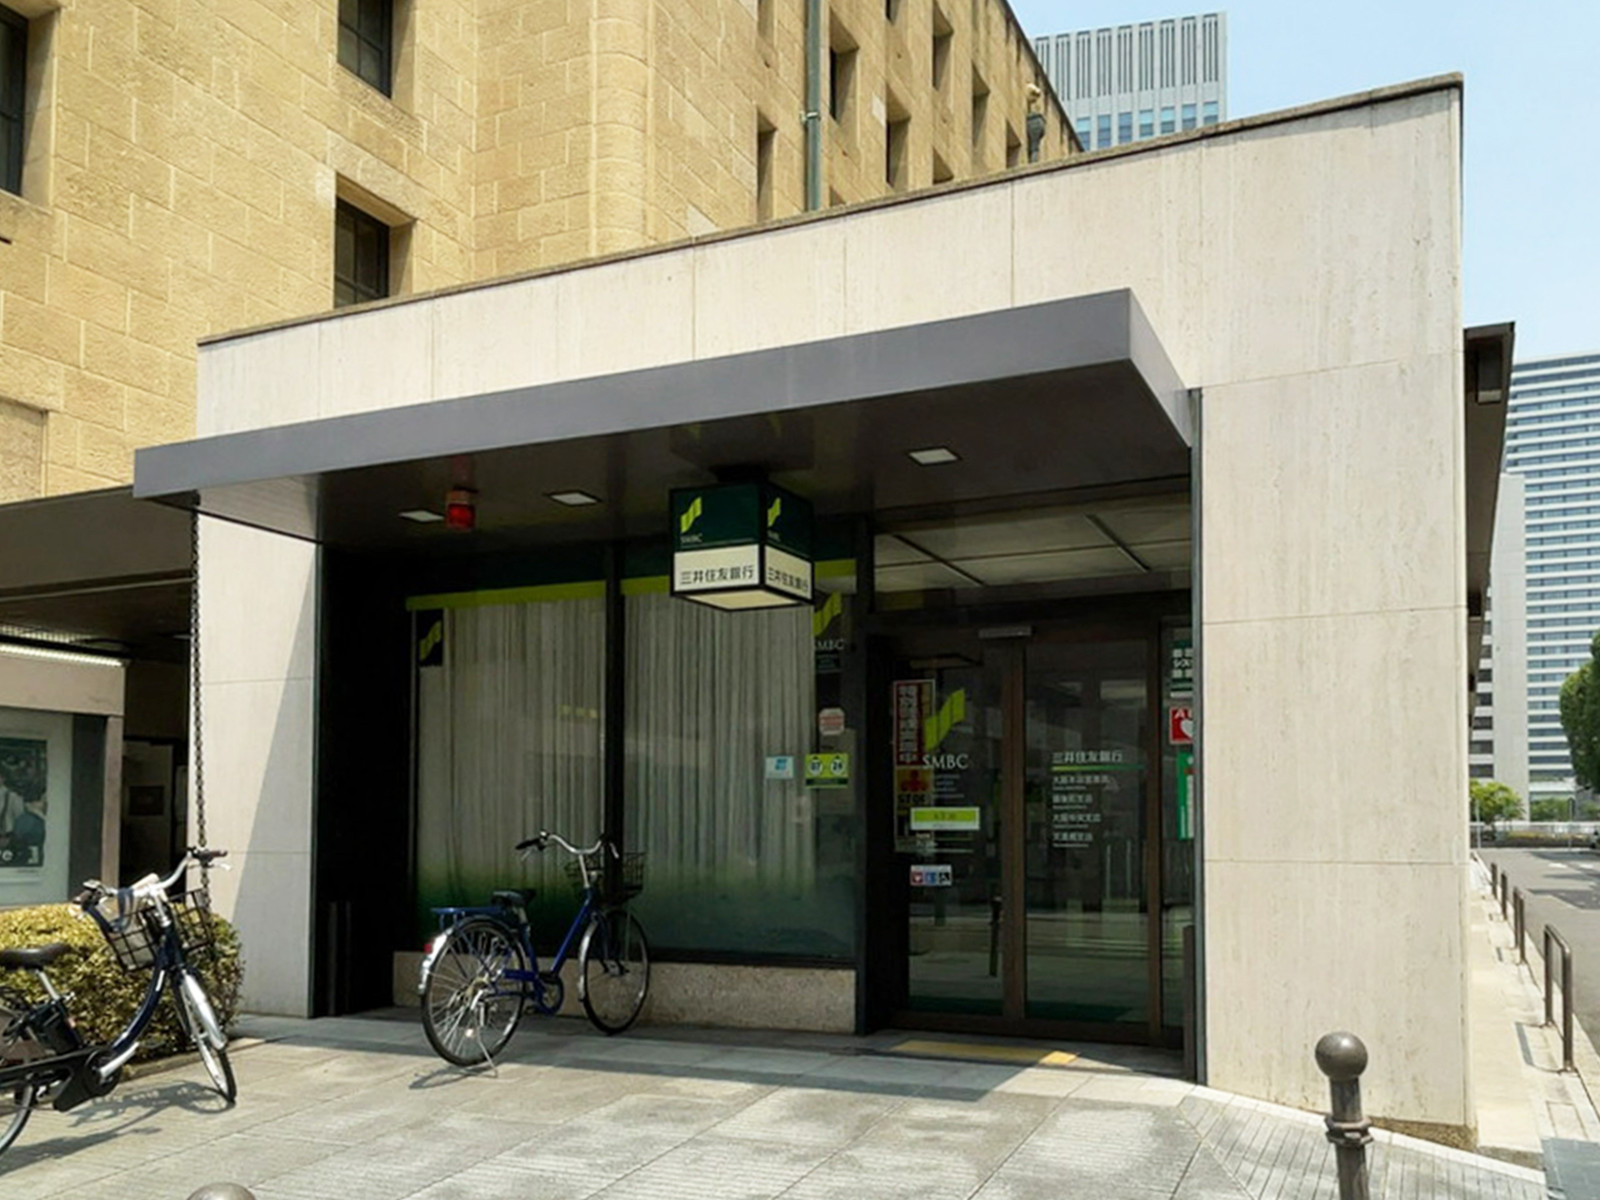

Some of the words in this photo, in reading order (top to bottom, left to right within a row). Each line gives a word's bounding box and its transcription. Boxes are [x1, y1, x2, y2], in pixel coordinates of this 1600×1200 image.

[680, 565, 754, 586] 三井住友銀行
[815, 638, 845, 651] MBC
[922, 754, 969, 769] SMBC
